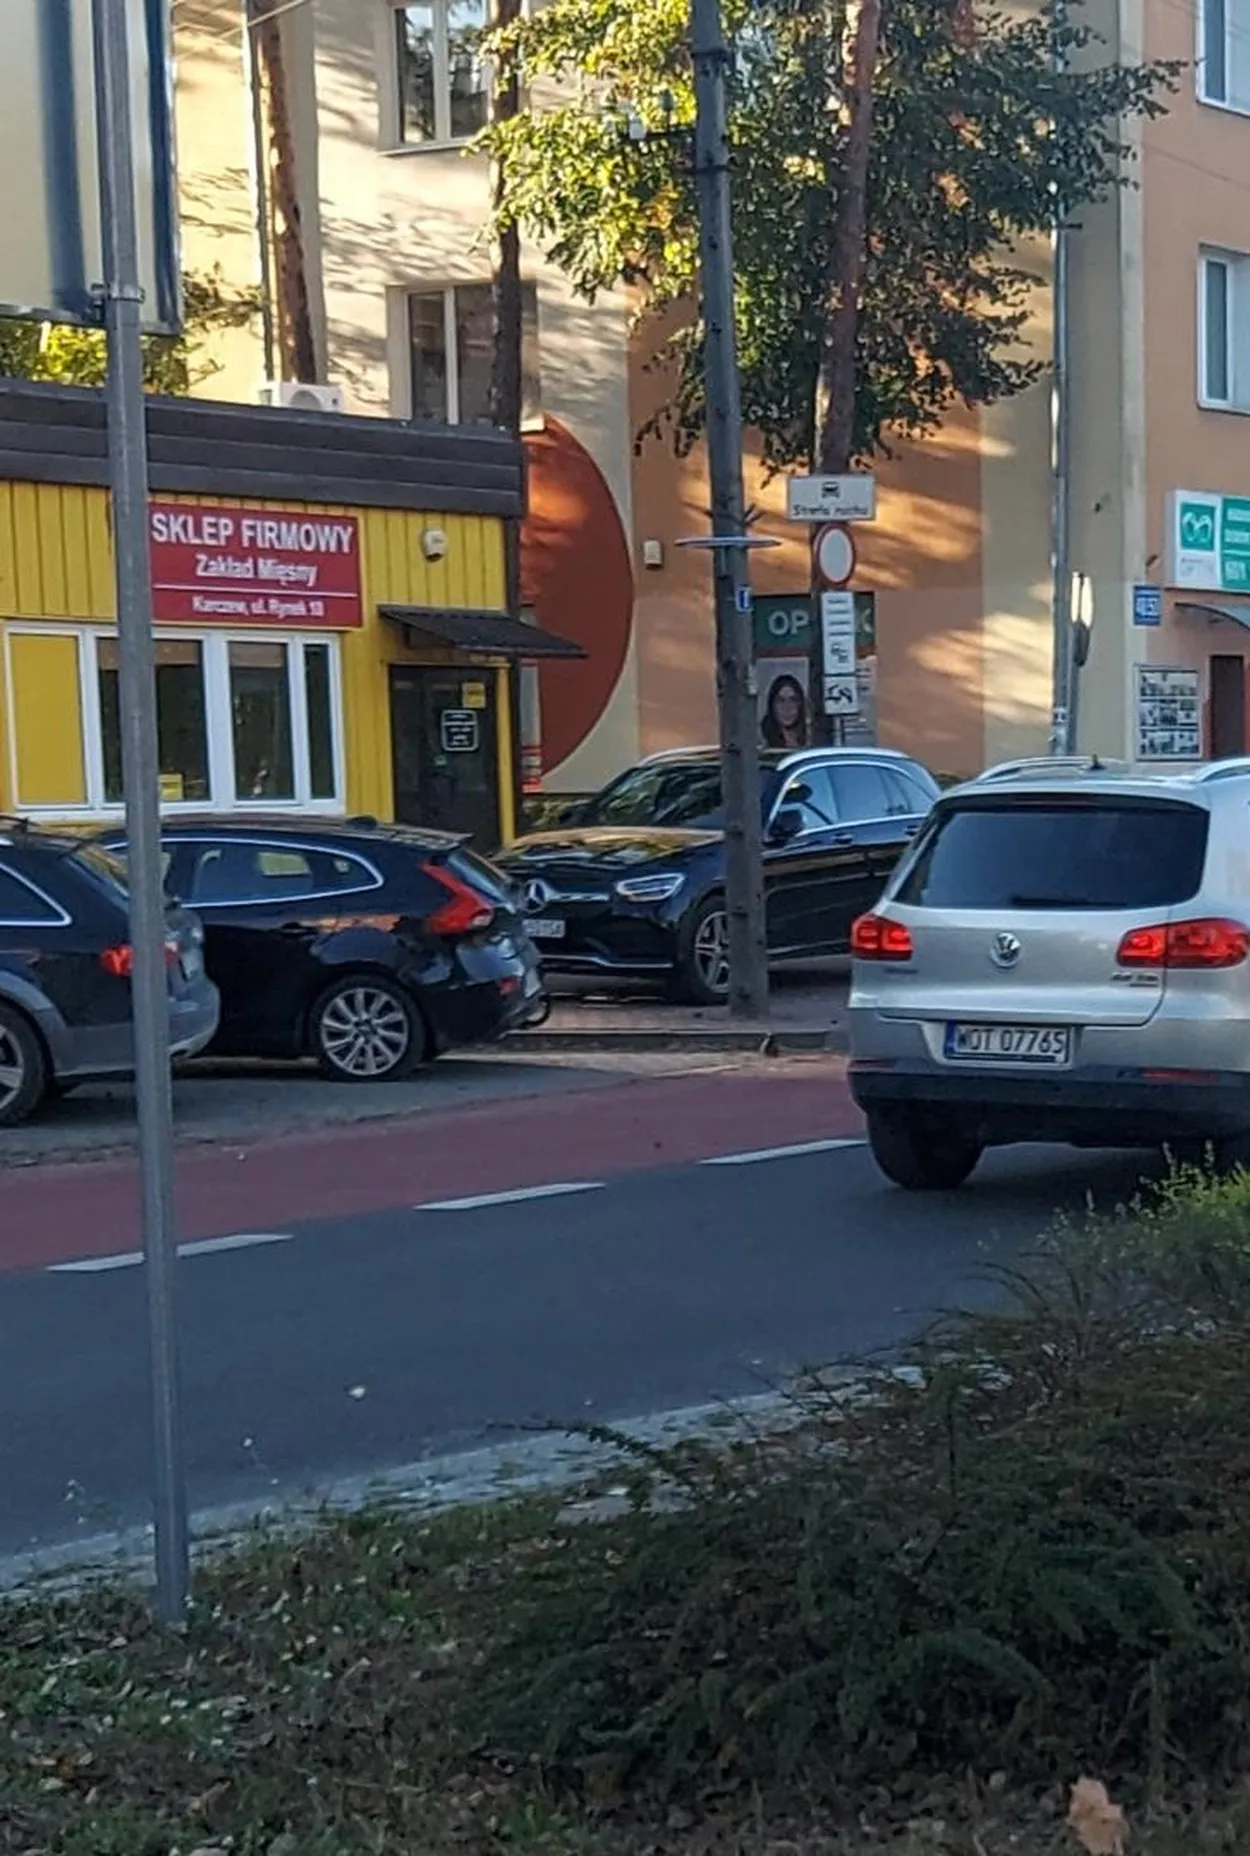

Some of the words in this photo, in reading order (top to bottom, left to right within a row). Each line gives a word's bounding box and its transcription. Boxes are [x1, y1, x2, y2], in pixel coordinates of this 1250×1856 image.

[151, 512, 234, 546] SKLEP
[241, 518, 353, 553] FIRMOWY
[957, 1028, 995, 1051] WOT
